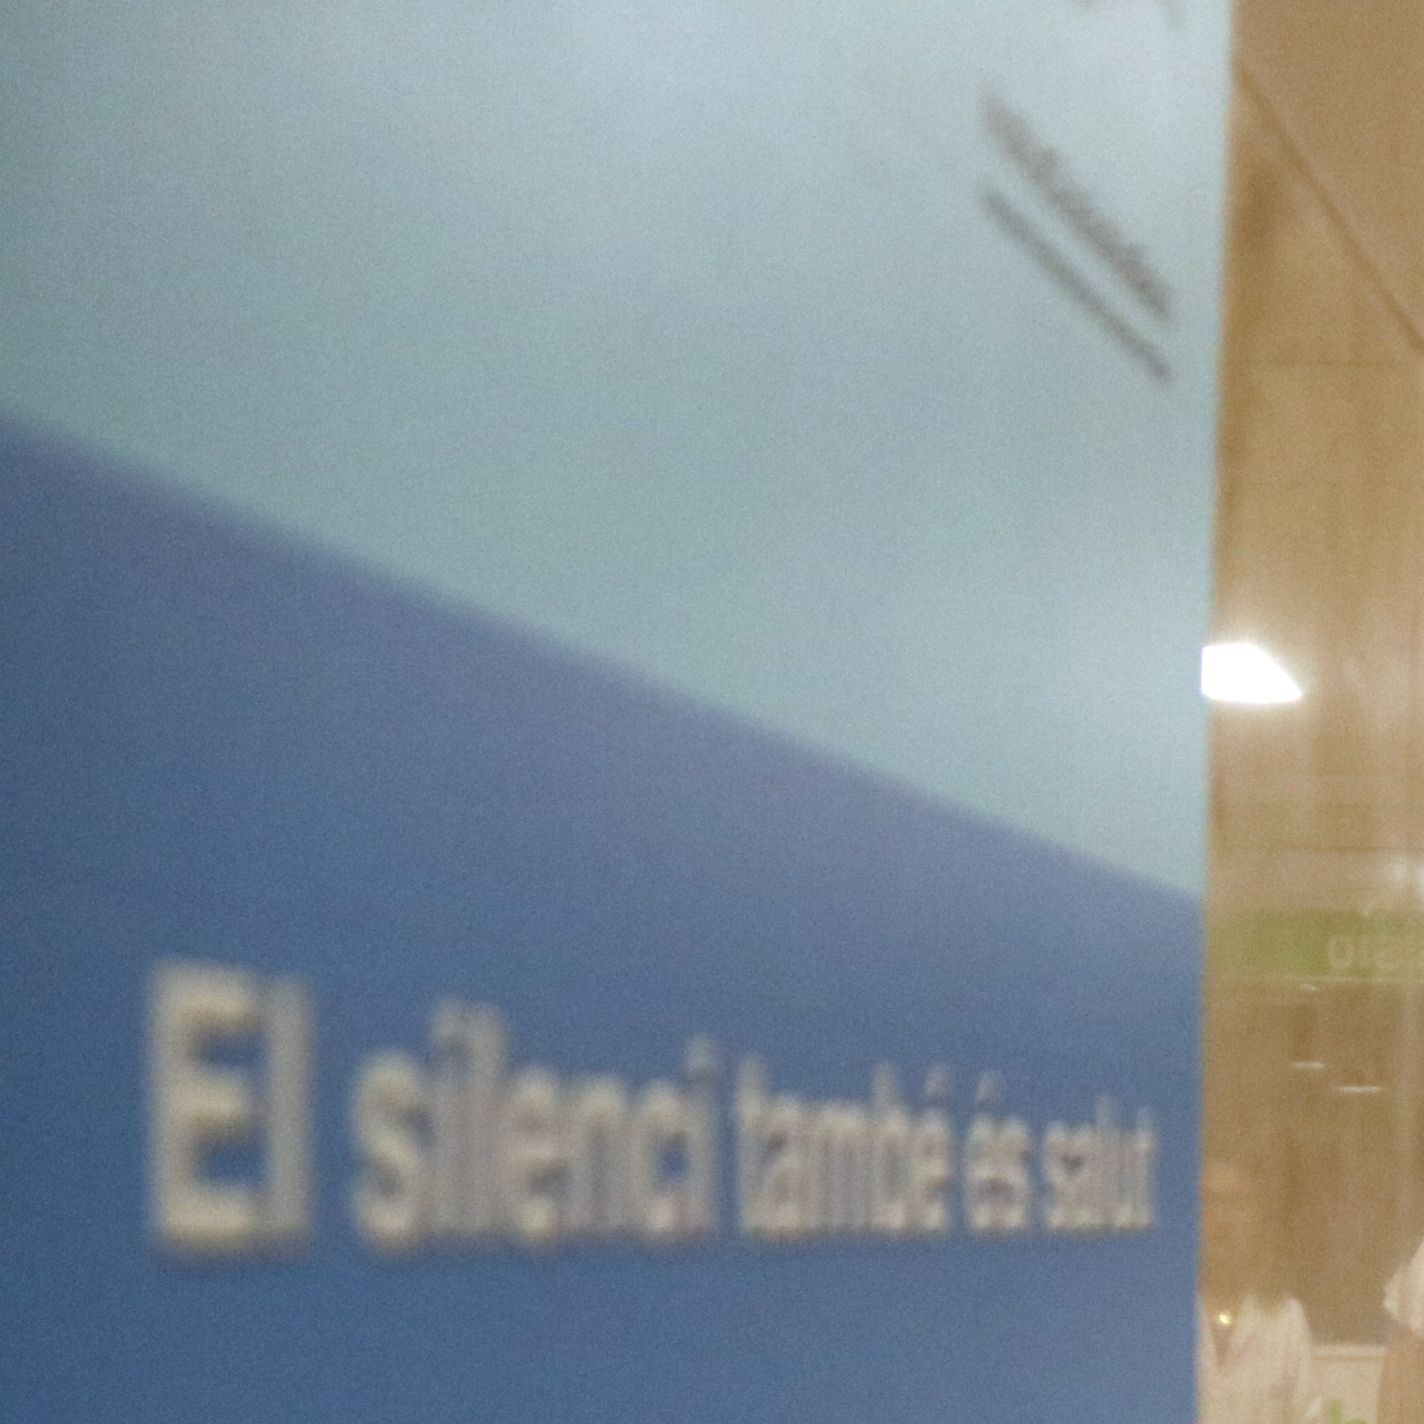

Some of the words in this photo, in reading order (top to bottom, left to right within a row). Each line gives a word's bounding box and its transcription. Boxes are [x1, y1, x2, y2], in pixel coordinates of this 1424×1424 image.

[155, 962, 312, 1250] El
[352, 1000, 718, 1248] silenci
[736, 1055, 950, 1240] també
[965, 1070, 1031, 1235] és
[1043, 1097, 1158, 1235] salut
